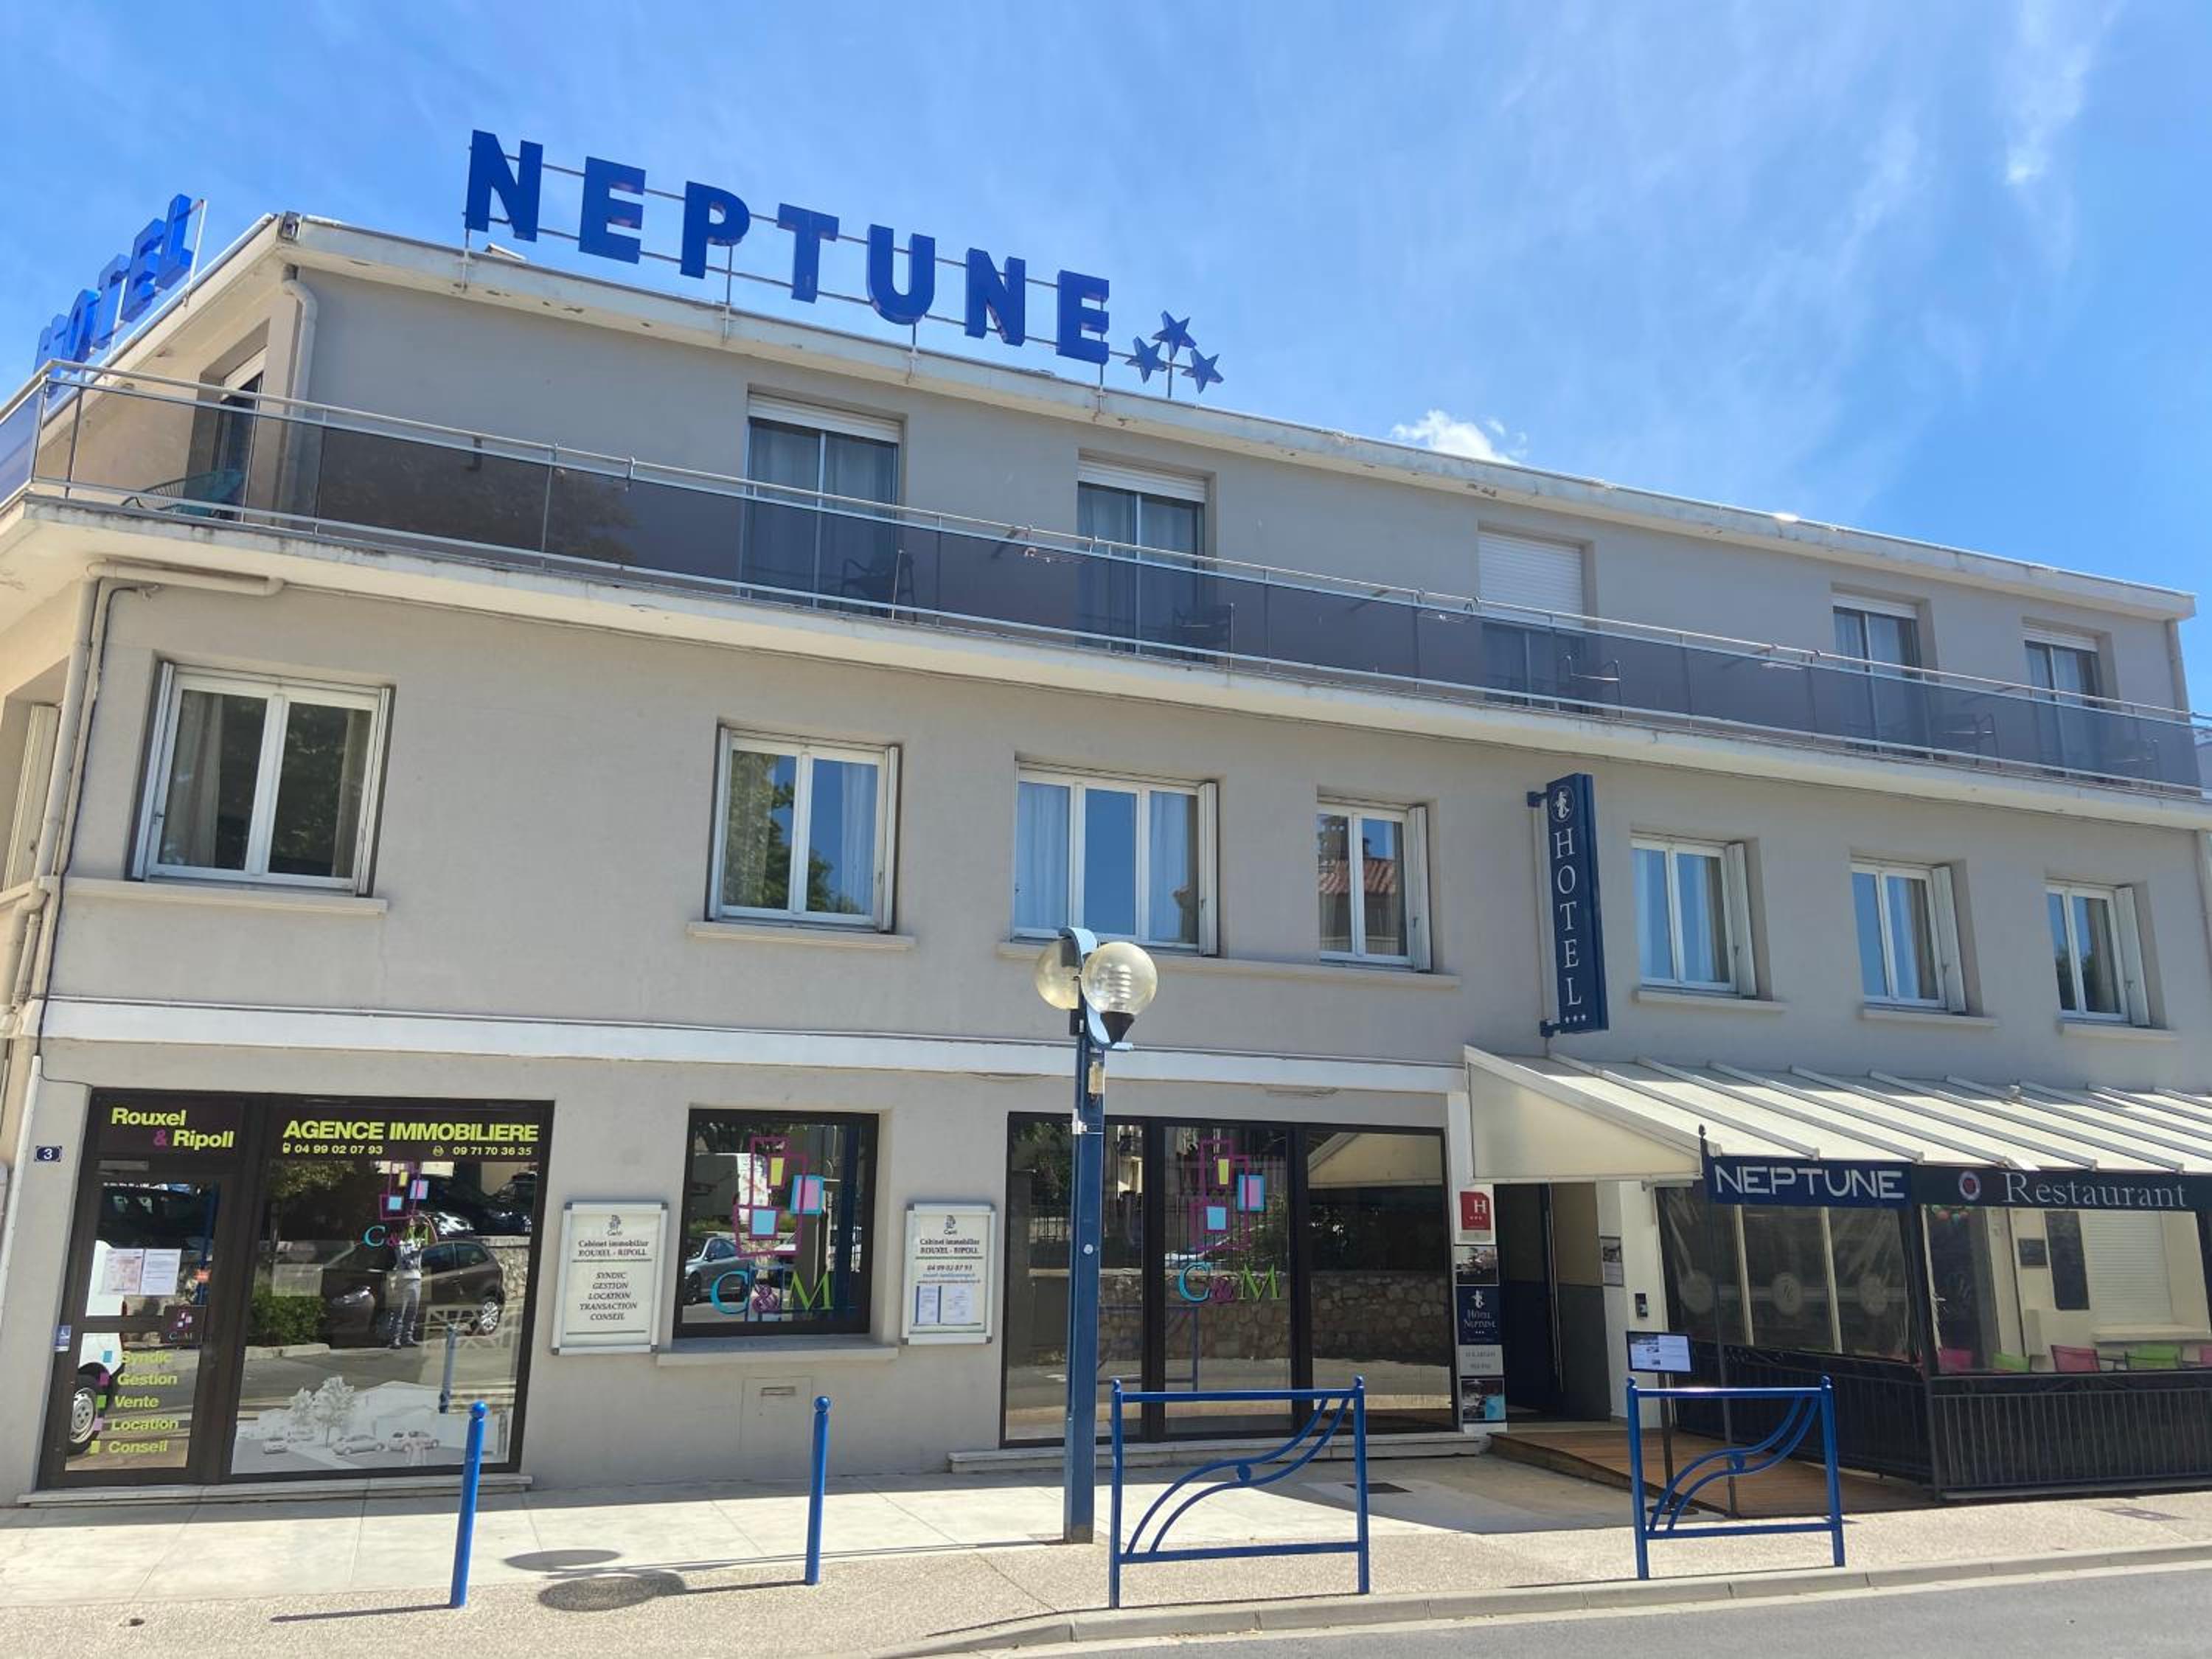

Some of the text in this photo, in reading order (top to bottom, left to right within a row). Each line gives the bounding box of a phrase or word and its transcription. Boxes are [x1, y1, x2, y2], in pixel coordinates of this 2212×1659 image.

[465, 129, 1110, 365] NEPTUNE
[1554, 827, 1582, 1006] HOTEL
[111, 1107, 187, 1126] Rouxel
[282, 1120, 540, 1142] AGENCE IMMOBILIERE
[154, 1130, 235, 1150] & Ripoll
[43, 1148, 53, 1160] 3
[295, 1144, 310, 1154] 04
[332, 1145, 347, 1154] 02
[1714, 1164, 1905, 1199] NEPTUNE
[2000, 1172, 2188, 1208] Restaurant
[1474, 1200, 1487, 1214] H
[578, 1239, 608, 1248] Cabinet
[592, 1281, 629, 1290] GESTION
[588, 1292, 631, 1300] LOCATION
[579, 1301, 638, 1310] TRANSACTION
[590, 1312, 625, 1321] CONSEIL
[117, 1374, 178, 1385] Gestion
[114, 1395, 159, 1408] Vente
[111, 1418, 179, 1430] Location
[108, 1440, 168, 1453] Conseil
